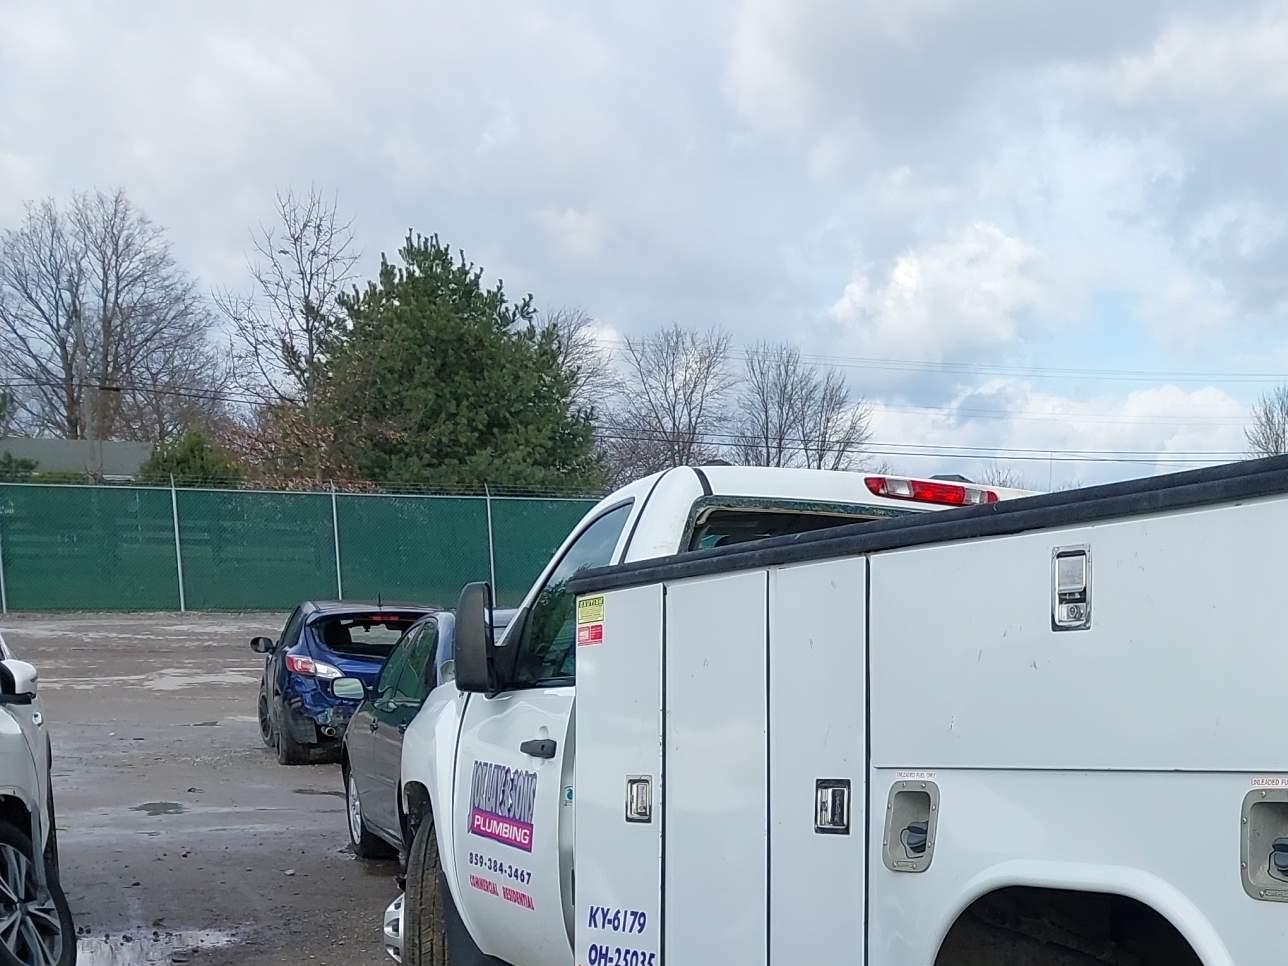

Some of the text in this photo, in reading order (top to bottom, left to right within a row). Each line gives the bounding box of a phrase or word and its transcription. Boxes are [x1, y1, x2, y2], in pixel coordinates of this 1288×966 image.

[1251, 778, 1280, 786] UNLEADED
[474, 815, 530, 844] PLUMBING
[469, 852, 532, 885] 859-384-3467
[470, 875, 535, 911] COMMERCIAL RESIDENTIAL
[588, 905, 647, 934] KY-6179
